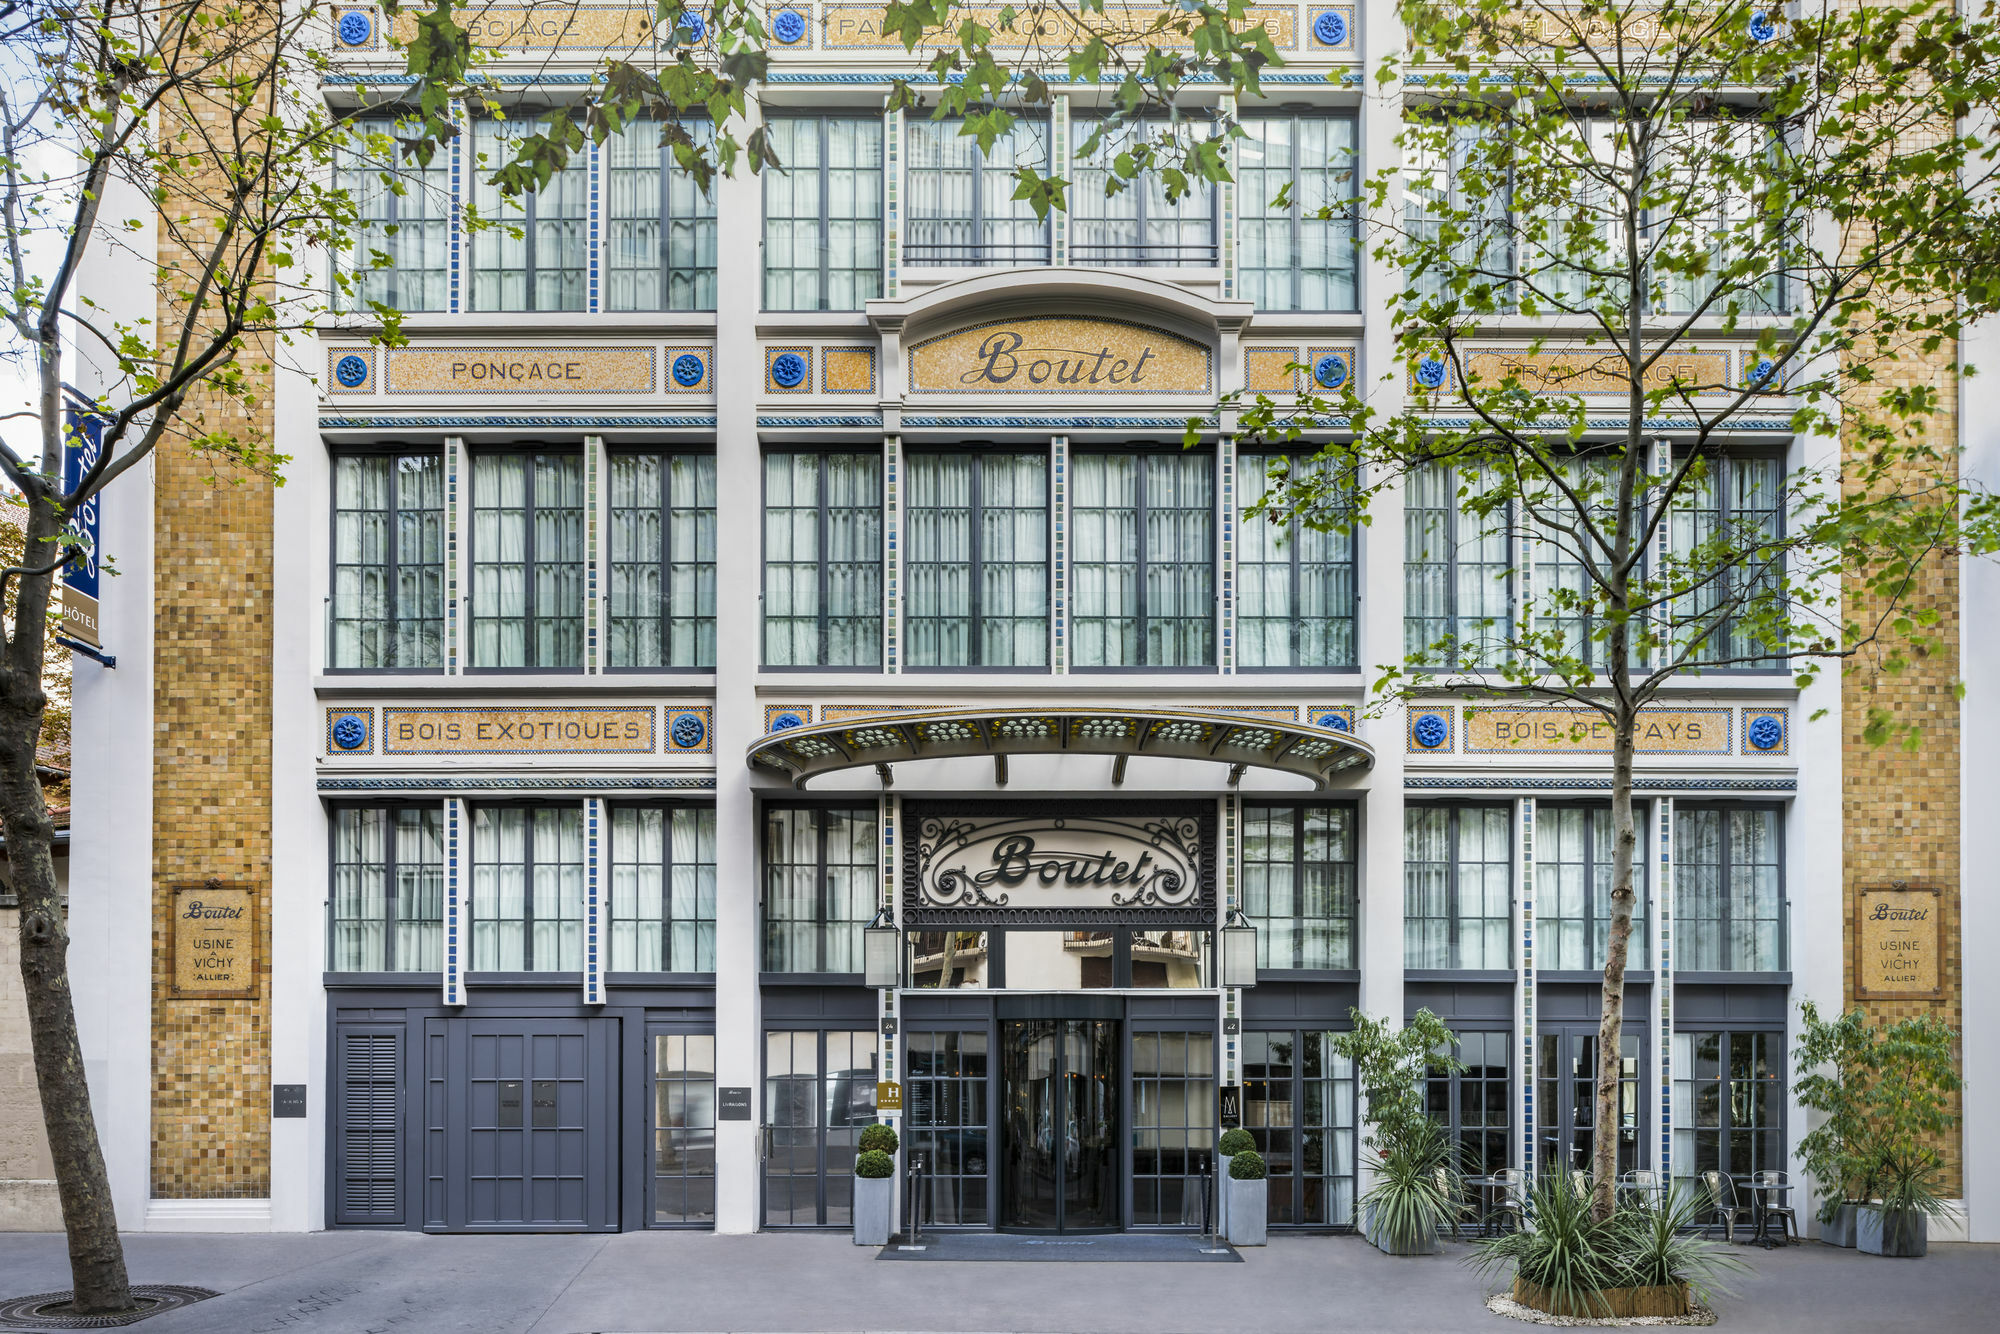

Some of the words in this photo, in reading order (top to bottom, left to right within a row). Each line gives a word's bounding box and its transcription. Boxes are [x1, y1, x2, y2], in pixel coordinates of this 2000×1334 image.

[466, 20, 580, 37] SCIAGE
[960, 331, 1156, 384] Boutet
[452, 362, 581, 382] PONÇAGE
[64, 604, 97, 630] HÔTEL
[399, 723, 461, 740] BOIS
[477, 721, 640, 741] EXOTIQUES
[1495, 722, 1558, 739] BOIS
[975, 836, 1153, 885] Boutet
[183, 901, 244, 919] Boutet
[1869, 903, 1928, 921] Boutet
[193, 939, 234, 949] USINE
[1880, 941, 1920, 951] USINE
[194, 958, 234, 968] VICHY
[1881, 959, 1920, 969] VICHY
[888, 1087, 899, 1098] H
